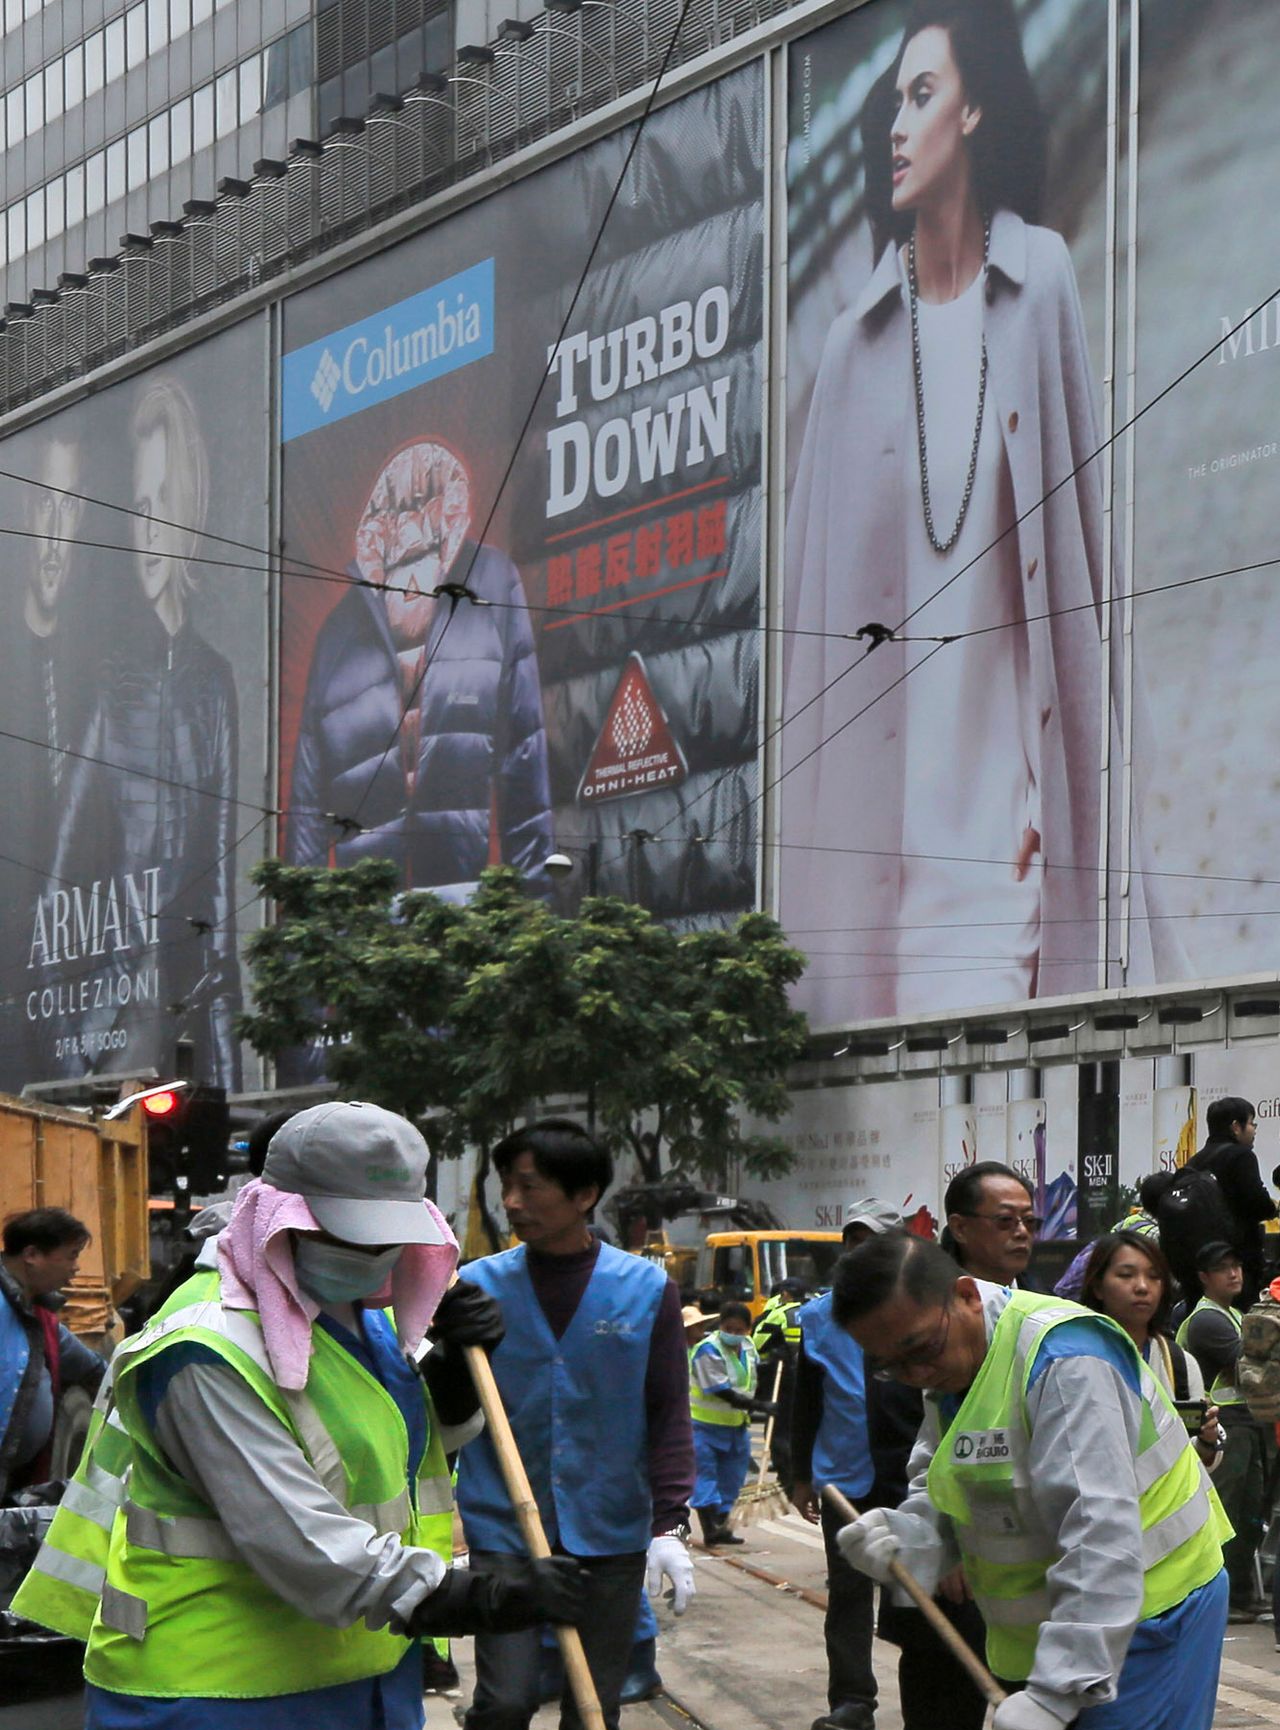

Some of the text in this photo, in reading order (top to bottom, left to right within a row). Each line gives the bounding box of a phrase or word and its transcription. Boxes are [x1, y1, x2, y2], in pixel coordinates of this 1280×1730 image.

[343, 294, 481, 397] Columbia
[547, 285, 730, 418] TURBO
[545, 375, 731, 519] DOWN
[1188, 463, 1207, 481] THE
[1210, 442, 1278, 473] ORIGINATOR
[583, 765, 679, 797] OMNI-HEAT
[595, 752, 669, 779] THERMAL REFLECTIVE
[26, 866, 161, 970] ARMANI
[26, 967, 160, 1022] COLLEZIONI
[98, 1028, 128, 1050] SOGO
[1083, 1154, 1113, 1178] SK-II
[1088, 1176, 1108, 1187] MEN
